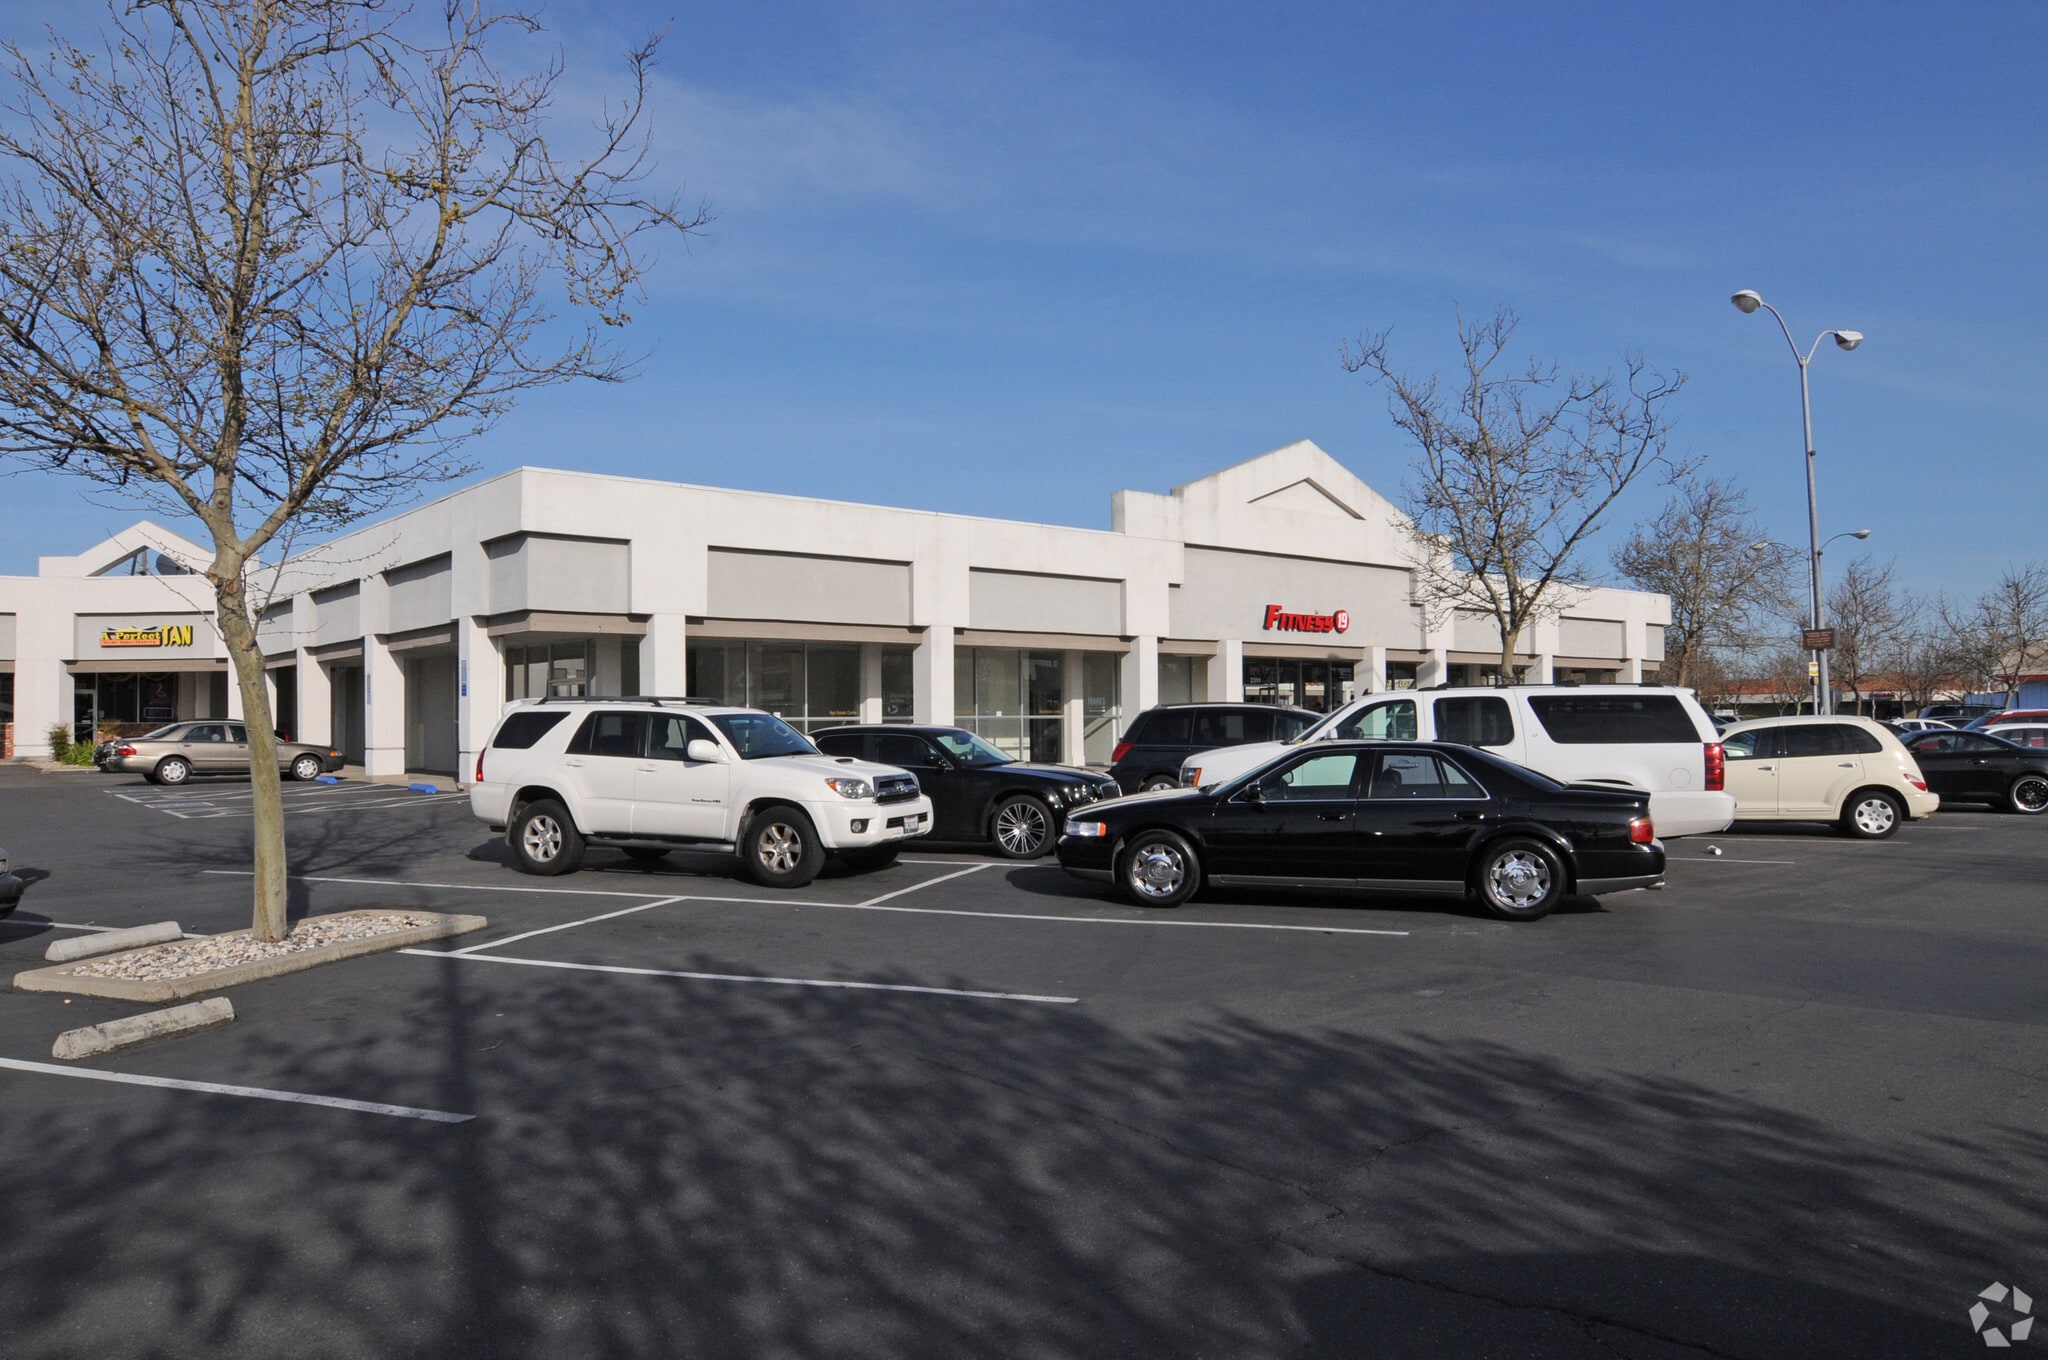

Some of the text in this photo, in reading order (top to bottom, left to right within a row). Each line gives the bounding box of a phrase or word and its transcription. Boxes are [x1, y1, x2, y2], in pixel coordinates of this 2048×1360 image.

[1338, 613, 1348, 628] 19
[101, 632, 110, 640] A
[115, 632, 161, 640] Perfect
[161, 625, 193, 646] TAN
